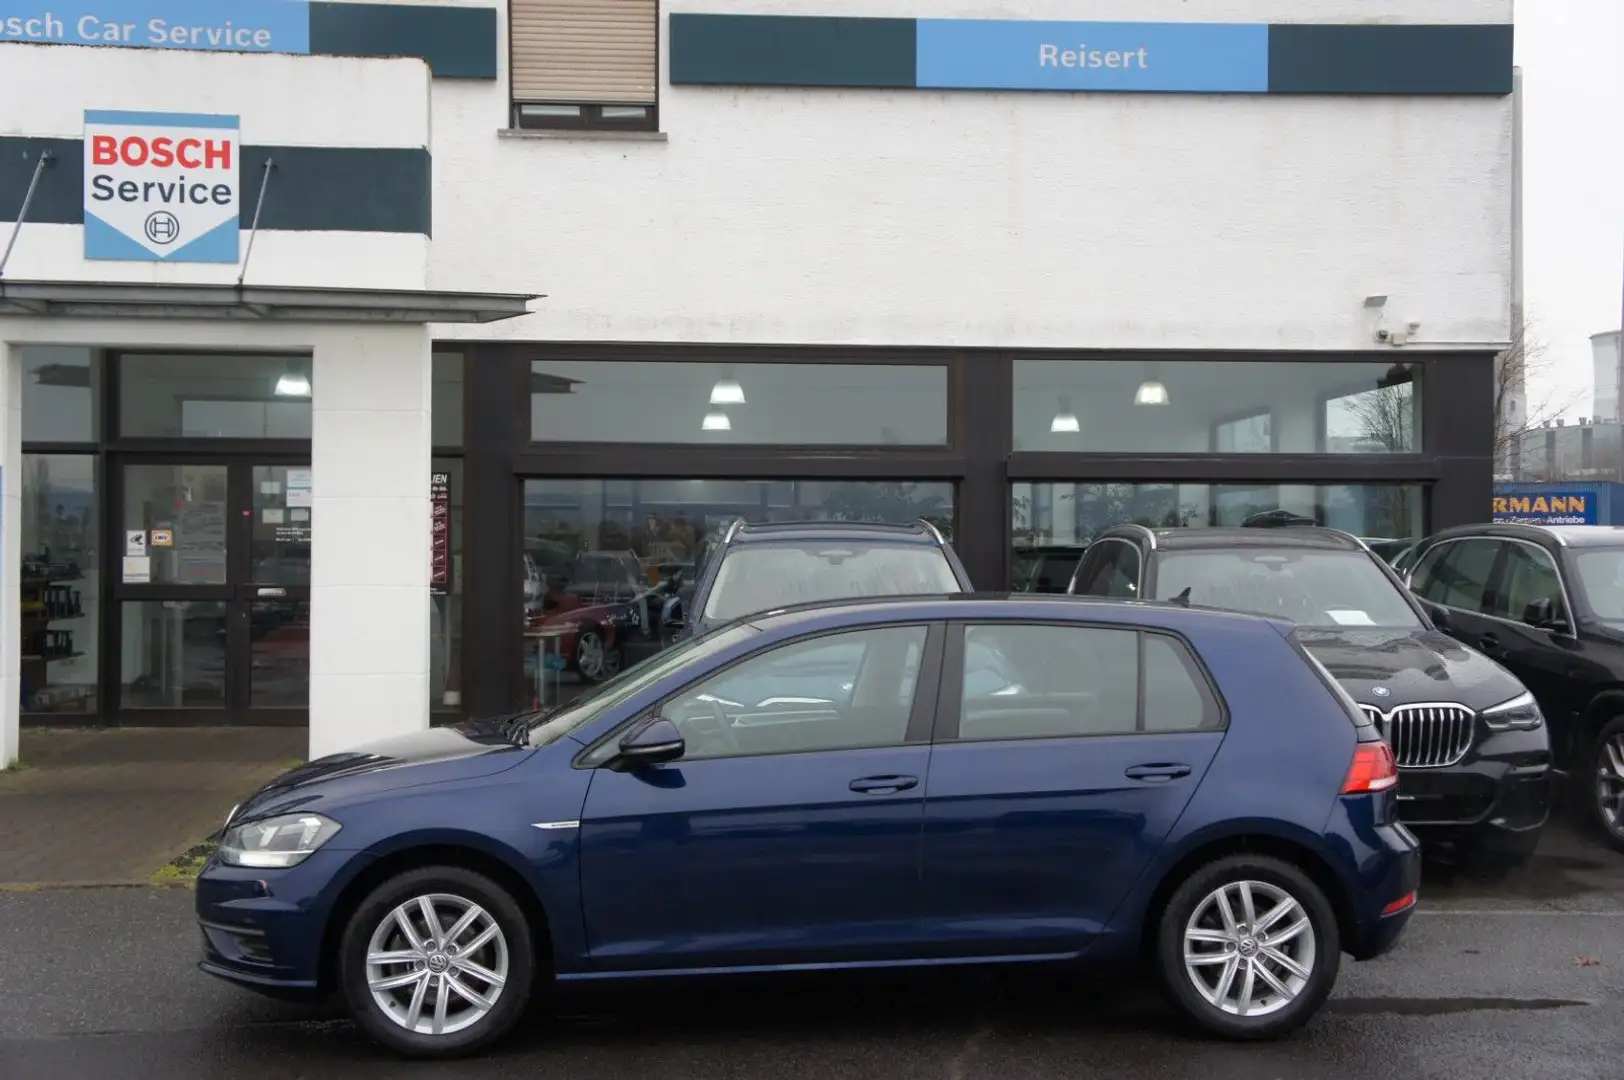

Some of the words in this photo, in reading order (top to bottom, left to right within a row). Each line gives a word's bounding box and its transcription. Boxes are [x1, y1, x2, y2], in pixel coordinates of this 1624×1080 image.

[0, 12, 64, 39] sch
[77, 14, 136, 41] Car
[147, 18, 272, 47] Service
[1039, 43, 1148, 69] Reisert
[92, 135, 231, 169] BOSCH
[91, 174, 232, 205] Service
[1547, 515, 1585, 524] Antriebe
